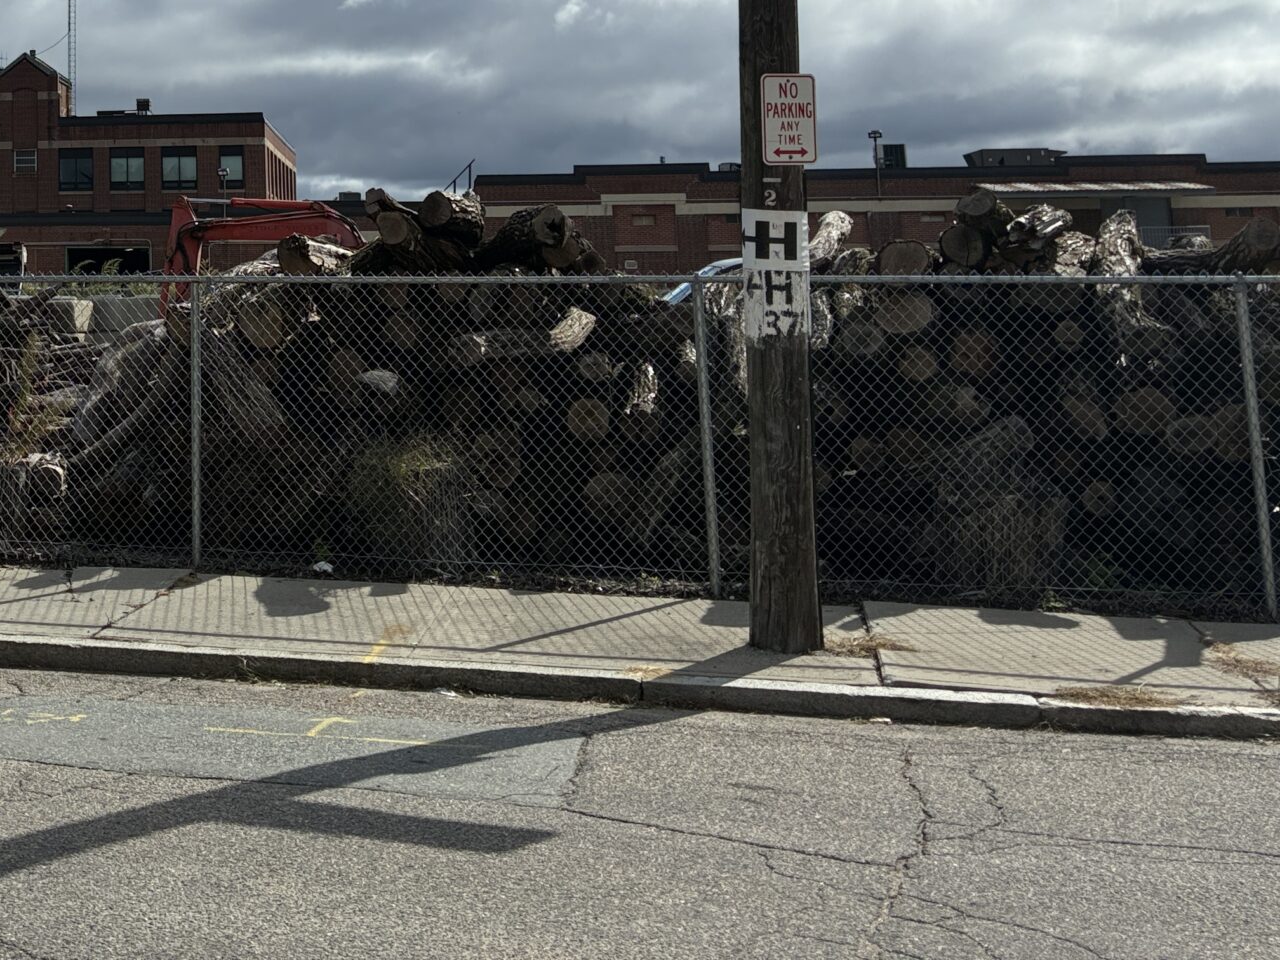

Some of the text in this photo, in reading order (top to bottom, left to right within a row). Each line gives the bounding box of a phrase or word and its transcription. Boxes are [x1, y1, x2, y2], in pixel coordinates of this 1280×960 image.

[778, 82, 798, 99] NO
[766, 102, 812, 119] PARKING
[780, 120, 800, 132] ANY
[777, 134, 803, 145] TIME
[764, 189, 777, 206] 2
[755, 220, 797, 260] H
